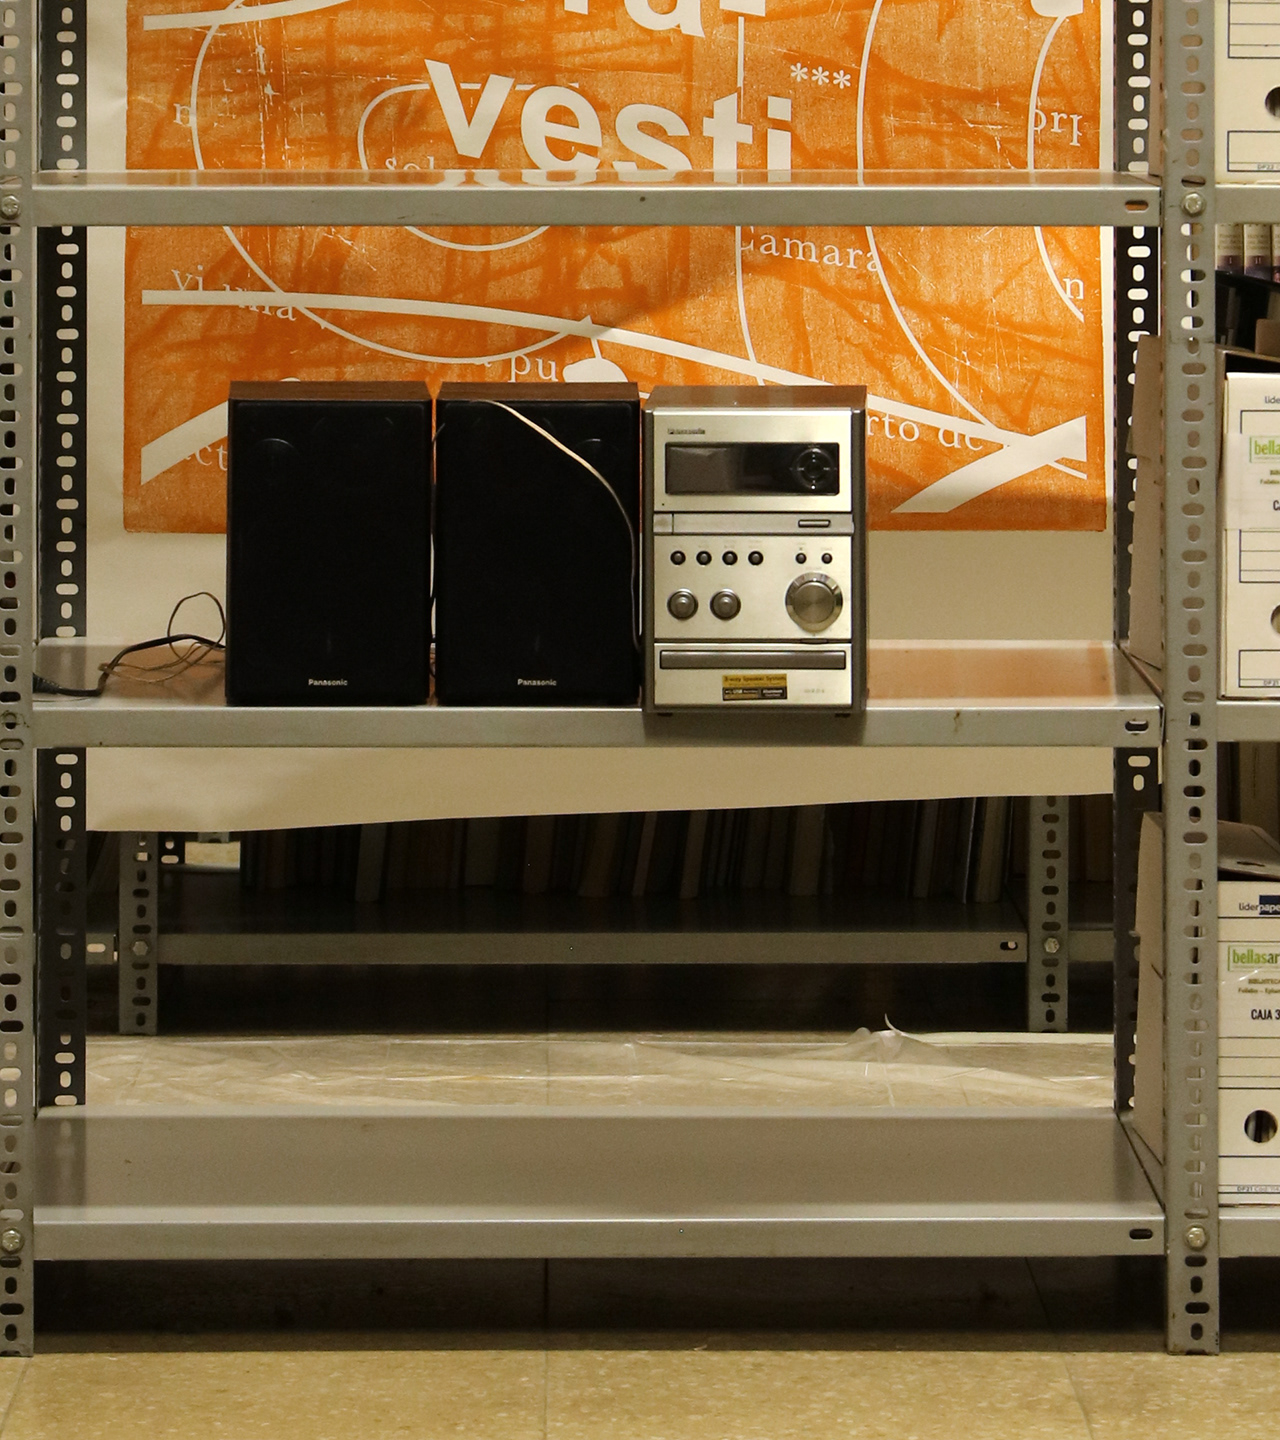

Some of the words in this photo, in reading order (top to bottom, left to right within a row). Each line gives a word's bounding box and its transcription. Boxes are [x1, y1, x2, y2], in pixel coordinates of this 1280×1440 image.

[424, 58, 792, 172] vesti
[308, 678, 348, 686] Panasonic
[517, 678, 557, 686] Panasonic
[1251, 1009, 1272, 1020] CAJA
